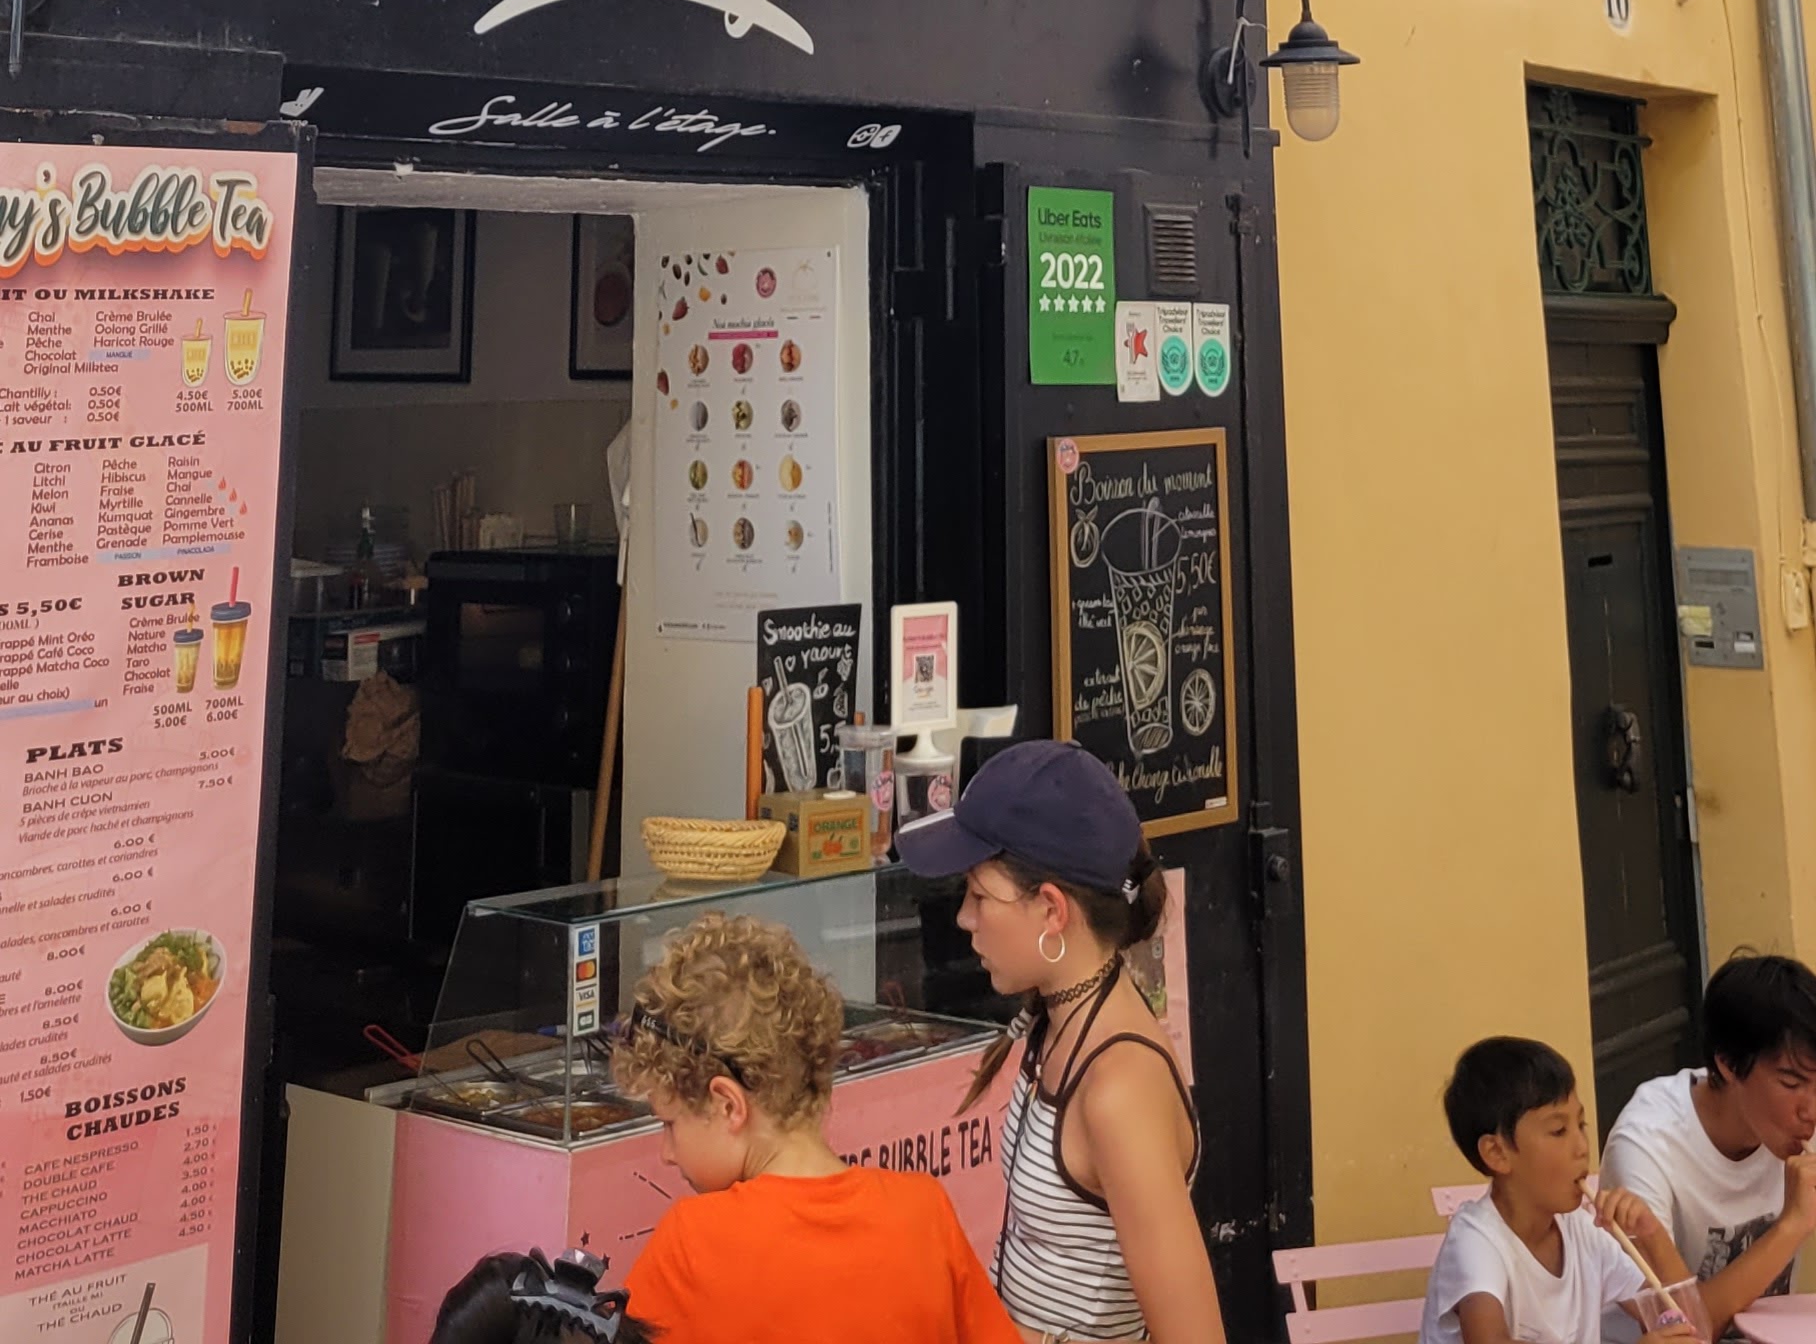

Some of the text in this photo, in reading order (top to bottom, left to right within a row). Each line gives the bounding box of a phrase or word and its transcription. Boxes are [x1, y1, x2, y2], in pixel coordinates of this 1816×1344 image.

[428, 95, 581, 135] Salle
[587, 110, 622, 129] à
[75, 170, 209, 241] Bubble
[215, 178, 269, 245] Tea
[1038, 207, 1103, 228] Uber Eats
[1039, 251, 1105, 290] 2022
[1, 289, 216, 301] IT OU MILKSHAKE
[28, 310, 173, 323] Chai Crème Brulée
[27, 322, 169, 336] Menthe Oolong Grillé
[25, 335, 175, 349] Pêche Haricot Rouge
[24, 349, 78, 362] Chocolat
[23, 361, 119, 376] Original Milktea
[89, 385, 122, 398] 0.50€
[175, 388, 263, 402] 4.50€ 5.00€
[87, 398, 121, 411] 0.50€
[175, 400, 265, 413] 500ML 700ML
[12, 411, 120, 425] saveur 0.50€
[9, 430, 207, 453] AU FRUIT GLACÉ
[33, 455, 201, 474] Citron Pêche Raisin
[32, 468, 214, 488] Litchi Hibiscus Mangue
[31, 481, 192, 501] Melon Fraise Chai
[30, 492, 213, 515] Kiwi Myrtille Cannelle
[28, 505, 226, 528] Ananas Kumquat Gingembre
[28, 517, 235, 541] Cerise Pastèque Pomme Vert
[27, 529, 246, 555] Menthe Grenade Pamplemousse
[26, 552, 90, 569] Framboise
[117, 568, 206, 588] BROWN
[16, 596, 83, 618] 5,50€
[120, 591, 196, 611] SUGAR
[129, 614, 165, 629] Crème
[762, 613, 857, 646] Smoothie au
[37, 629, 167, 647] Mint Oréo Nature
[37, 642, 168, 660] Café Coco Matcha
[36, 656, 151, 674] Matcha Coco Taro
[123, 667, 172, 683] Chocolat
[18, 685, 71, 704] au choix)
[122, 682, 155, 696] Fraise
[93, 697, 109, 708] un
[152, 695, 245, 717] 500ML 700ML
[153, 708, 239, 730] 5.00€ 6.00€
[25, 736, 124, 764] PLATS
[23, 763, 105, 784] BANH BAO
[22, 780, 60, 797] Brioche
[22, 791, 114, 814] BANH CUON
[64, 1076, 188, 1119] BOISSONS
[66, 1100, 182, 1142] CHAUDES
[878, 1115, 993, 1178] BUBBLE TEA
[24, 1140, 140, 1176] CAFE NESPRESSO
[22, 1160, 116, 1191] DOUBLE CAFE
[50, 1179, 98, 1199] CHAUD
[20, 1191, 109, 1221] CAPPUCCINO
[16, 1211, 139, 1251] CHOCOLAT CHAUD
[18, 1208, 98, 1236] MACCHIATO
[15, 1227, 133, 1266] CHOCOLAT LATTE
[13, 1246, 116, 1282] MATCHA LATTE
[61, 1273, 128, 1299] AU FRUIT
[69, 1303, 124, 1324] CHAUD
